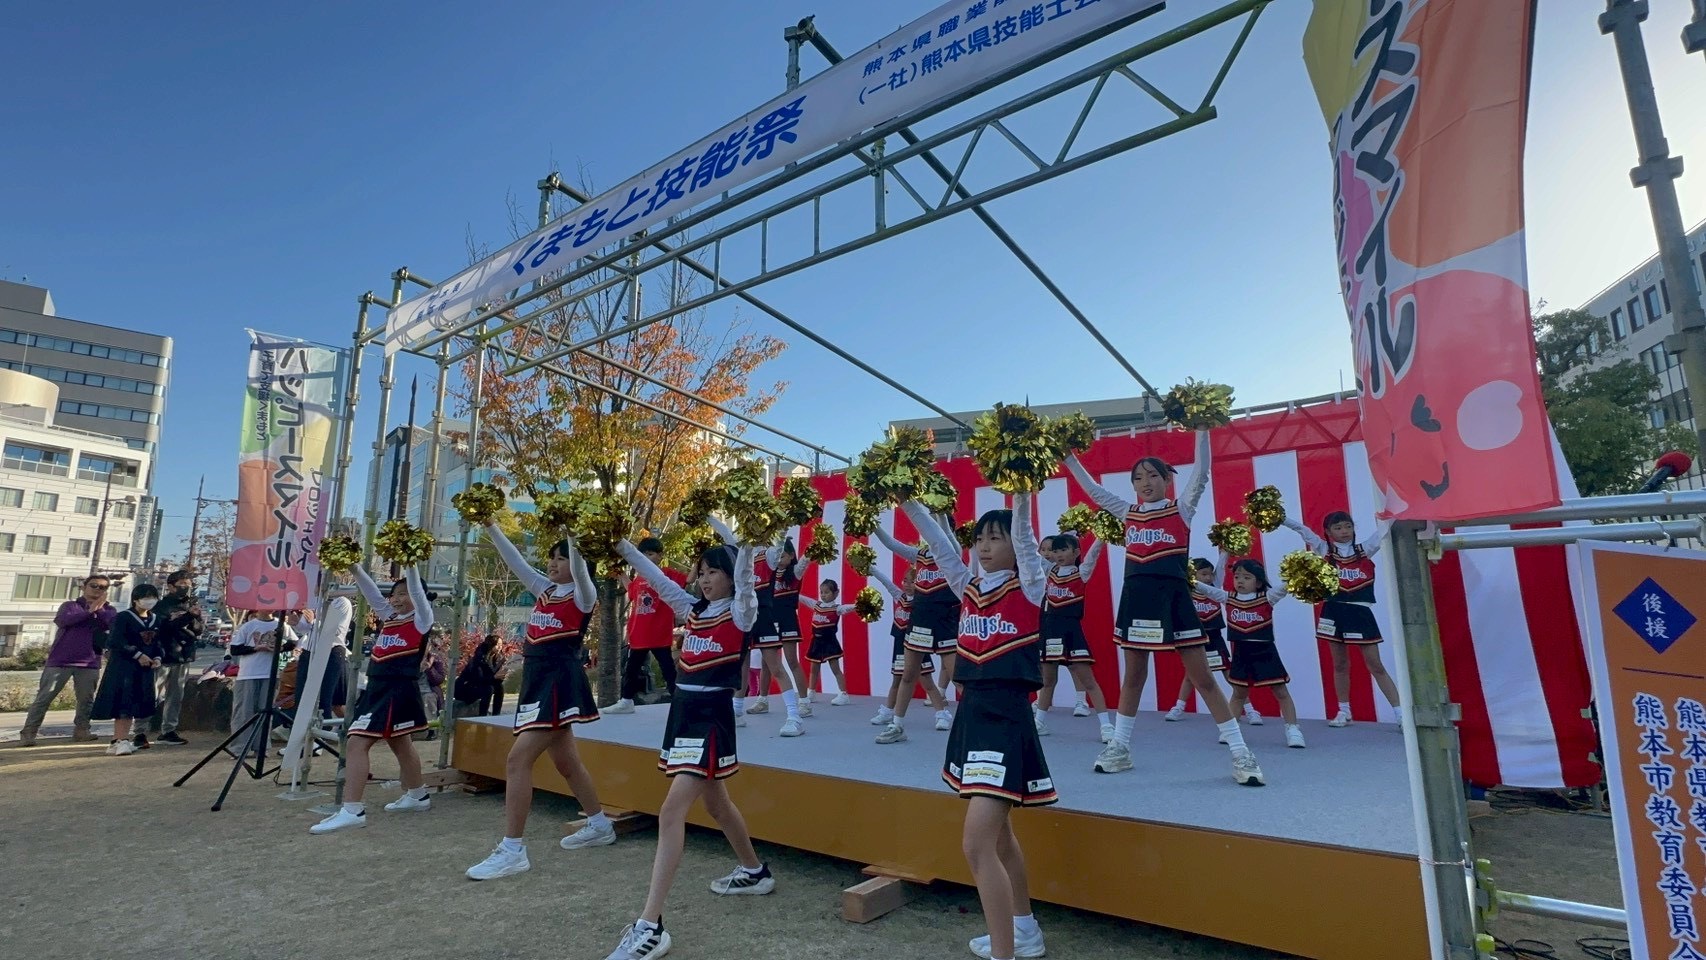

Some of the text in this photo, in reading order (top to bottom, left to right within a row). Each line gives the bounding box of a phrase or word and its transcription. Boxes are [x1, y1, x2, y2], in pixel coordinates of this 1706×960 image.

[512, 95, 807, 276] くまもと技能祭
[1352, 0, 1415, 394] スマイル
[530, 609, 555, 630] allys'
[999, 621, 1018, 634] Jr.
[1641, 593, 1670, 639] 後援
[709, 641, 724, 653] Jr.
